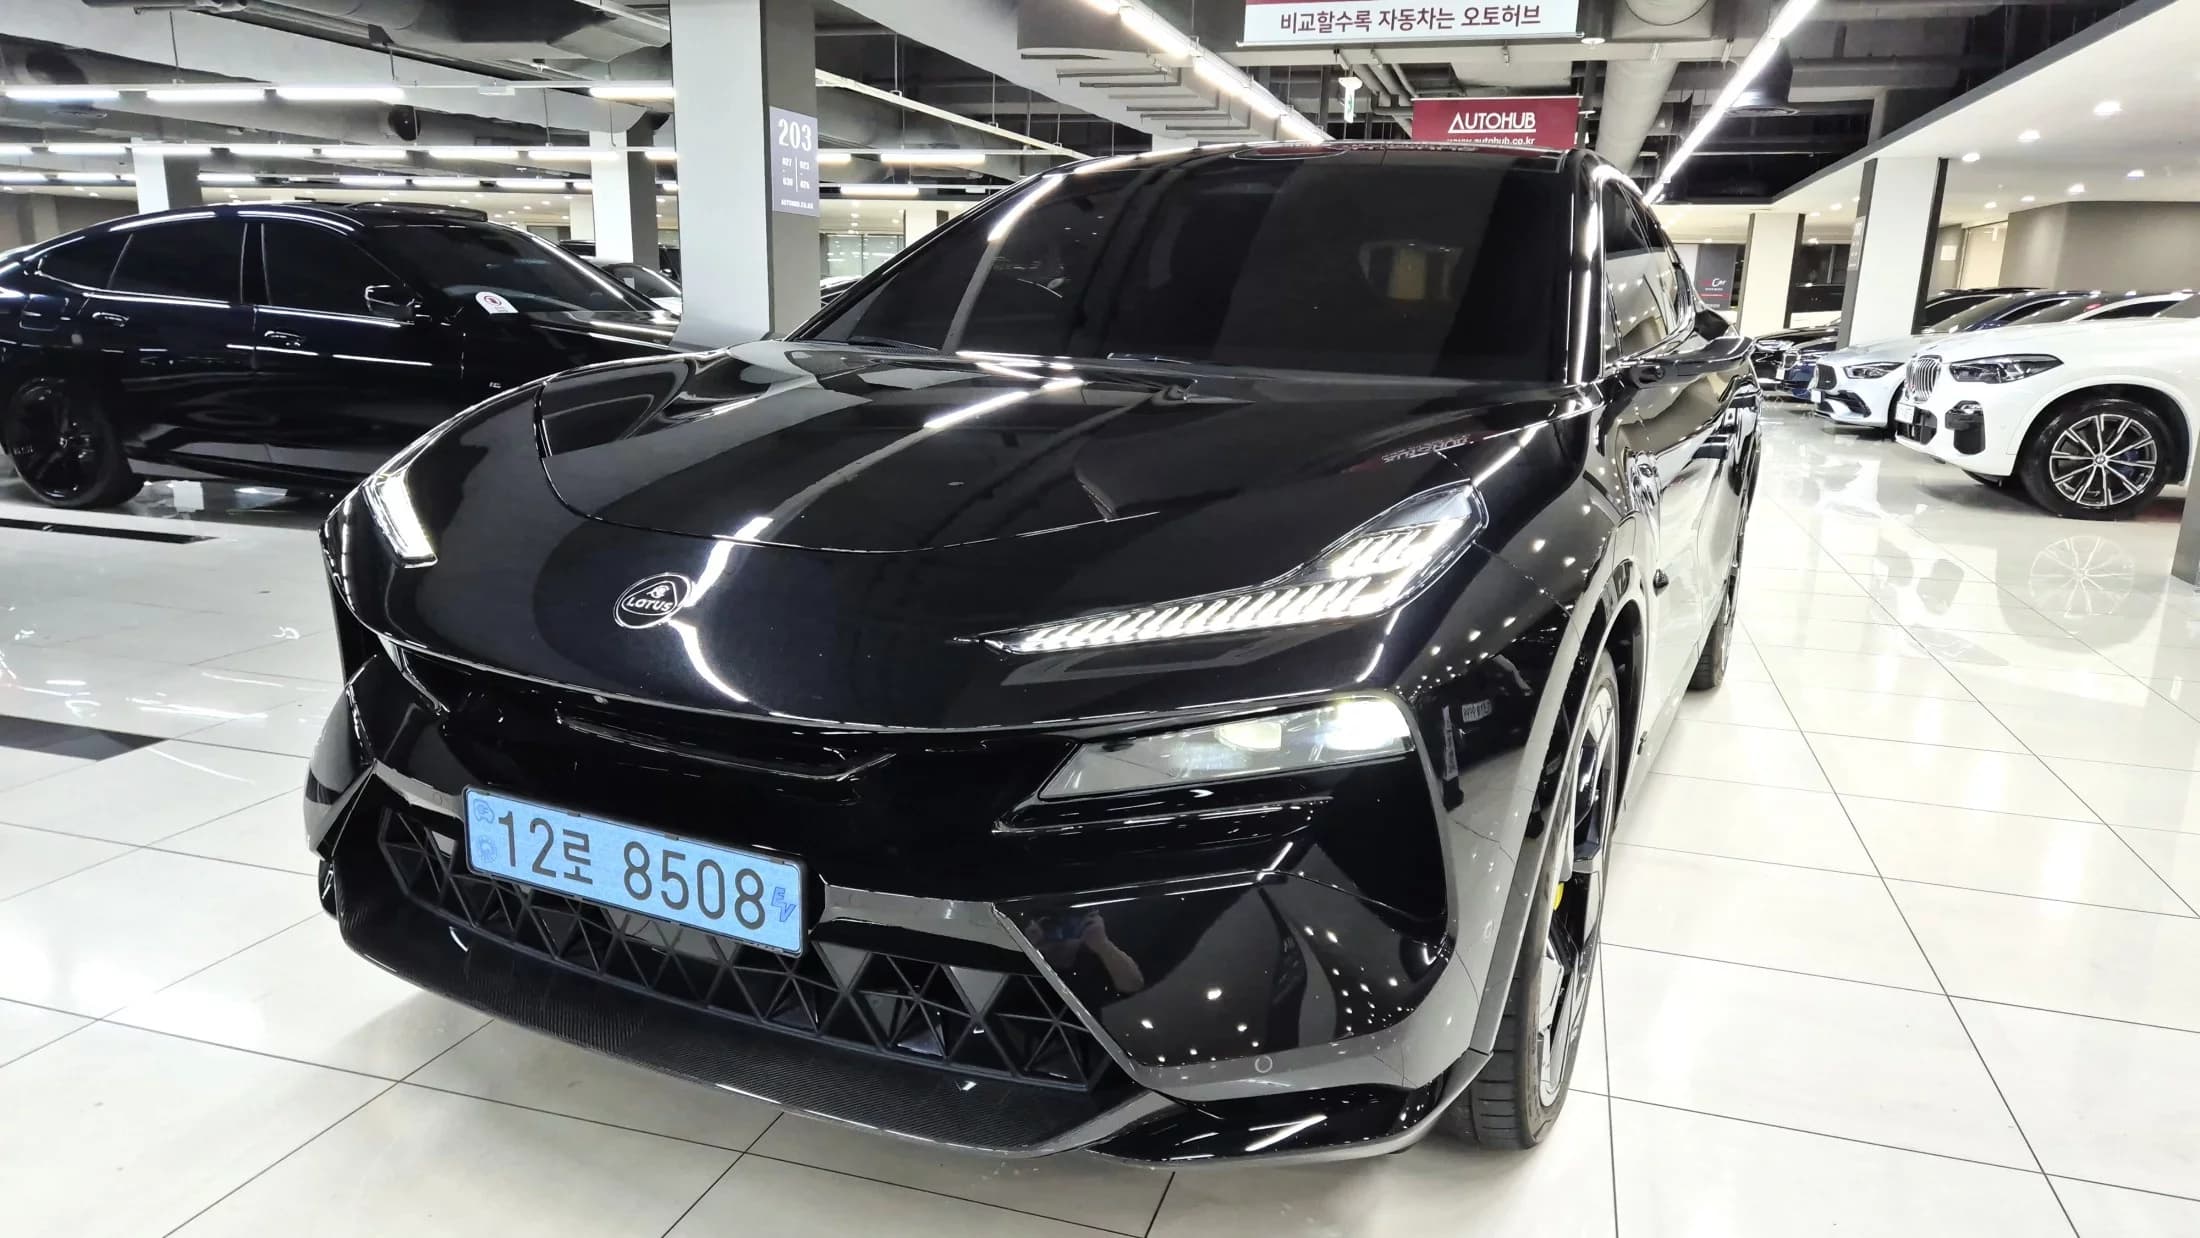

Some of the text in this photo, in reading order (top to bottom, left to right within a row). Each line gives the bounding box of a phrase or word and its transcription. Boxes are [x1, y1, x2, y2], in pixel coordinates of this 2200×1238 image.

[1280, 4, 1541, 34] 비교할수록 자동차는 오토허브
[778, 118, 812, 151] 203
[1448, 112, 1536, 132] AUTOHUB
[626, 597, 674, 611] LOTUS
[498, 810, 766, 930] 12로 8508
[771, 886, 796, 922] EV
